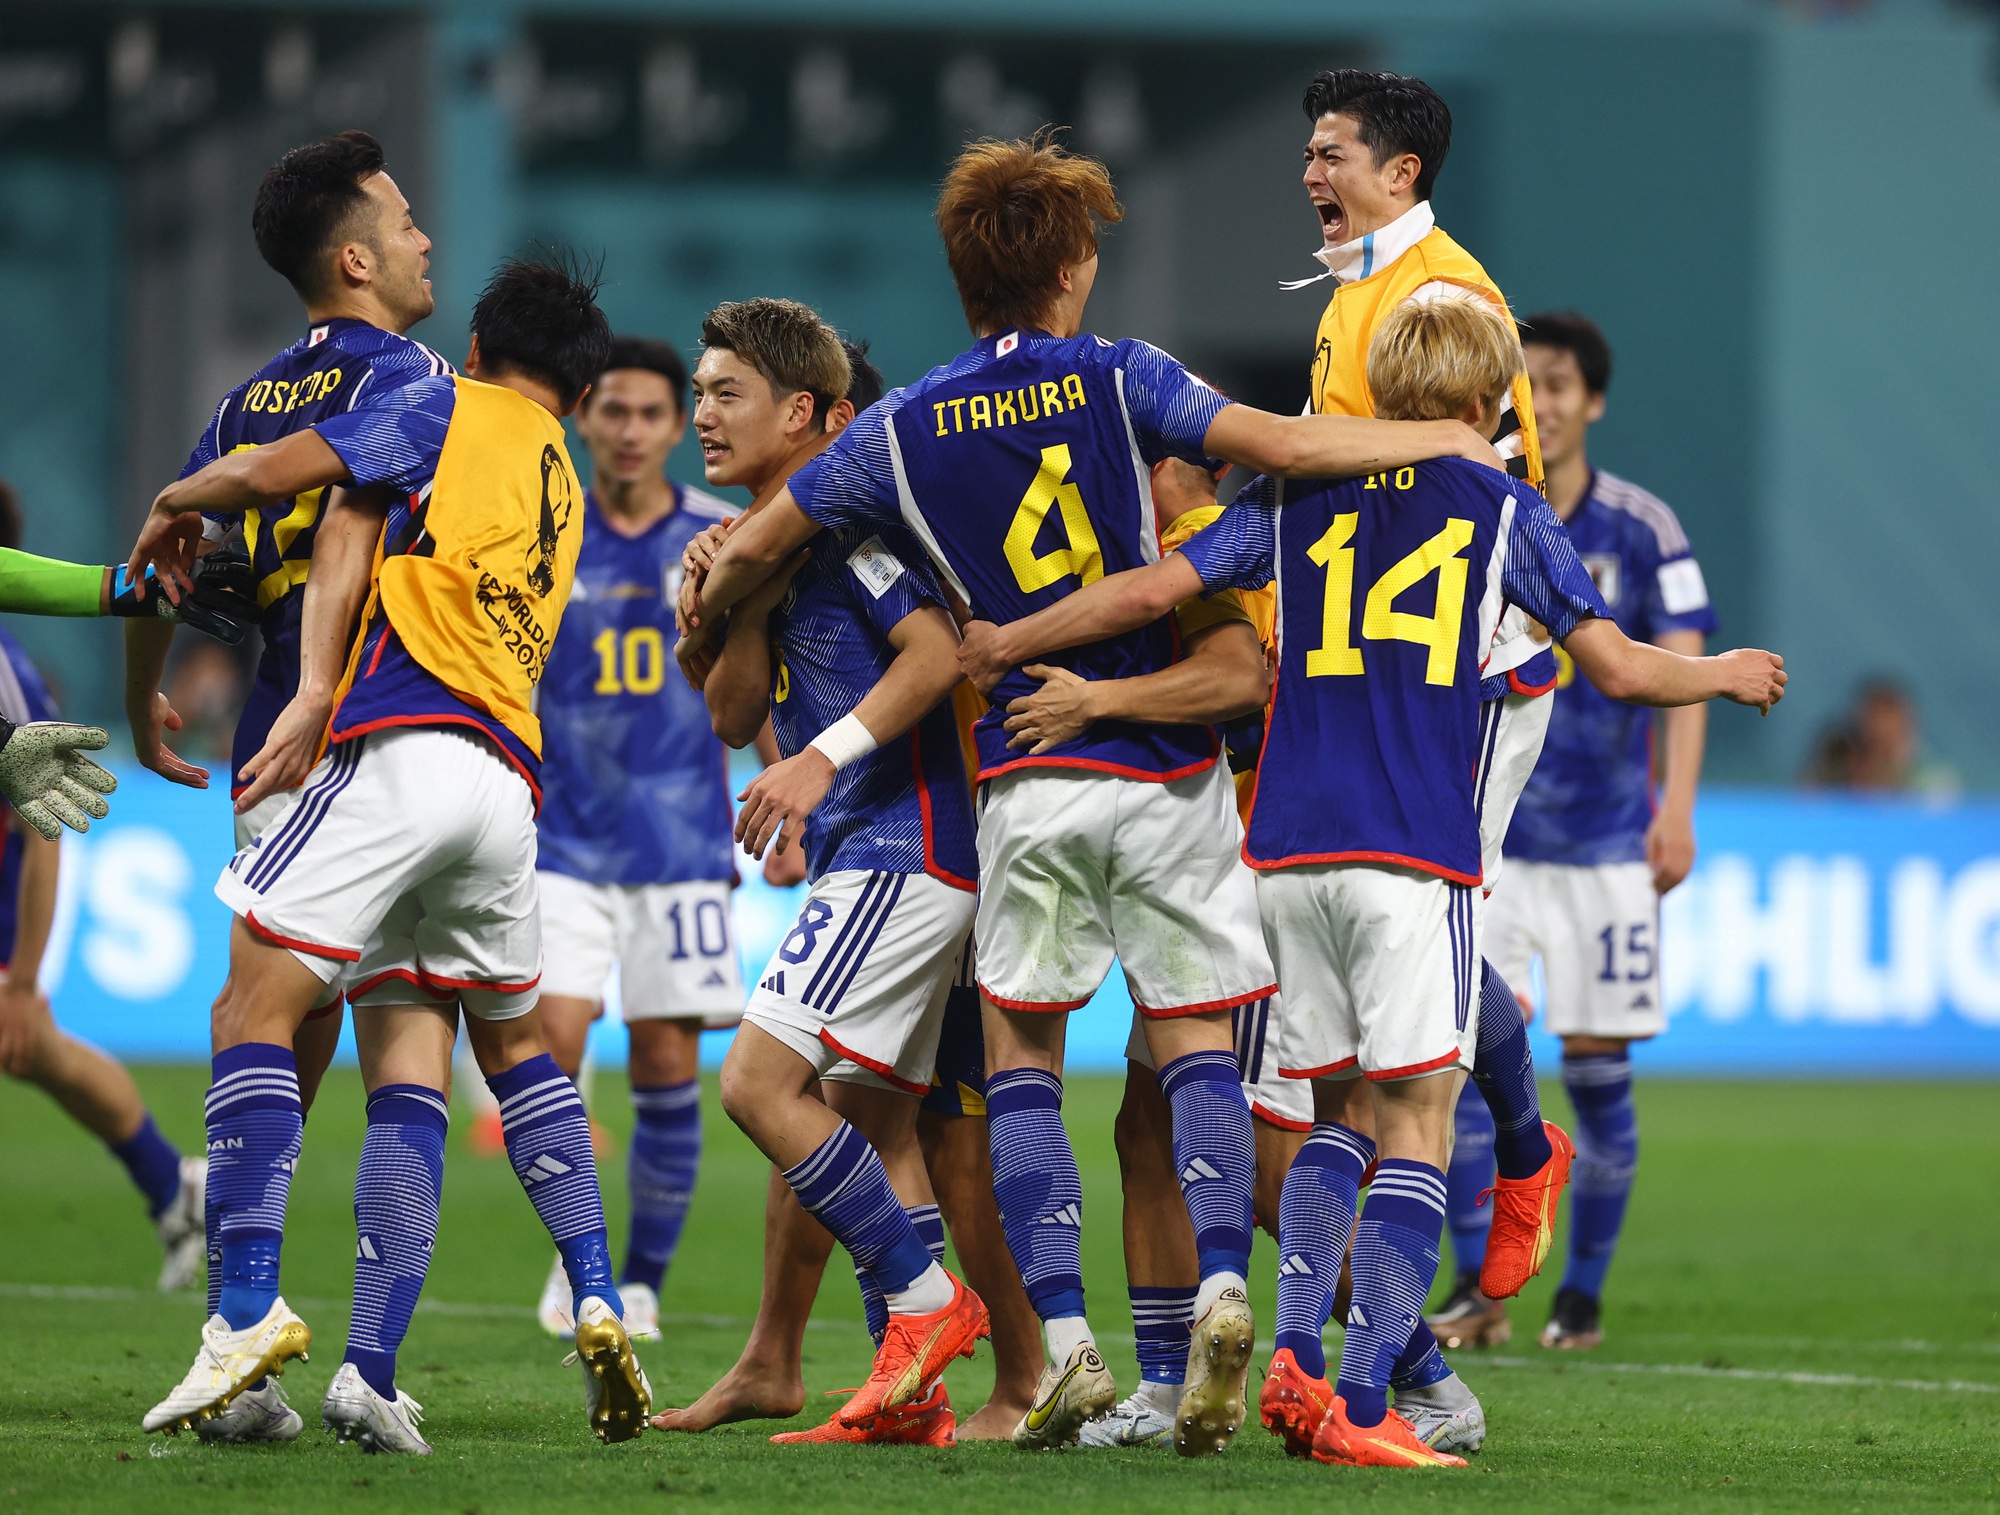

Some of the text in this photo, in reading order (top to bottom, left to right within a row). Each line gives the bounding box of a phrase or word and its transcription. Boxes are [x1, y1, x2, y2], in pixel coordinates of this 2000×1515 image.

[933, 373, 1087, 437] ITAKURA
[1003, 443, 1105, 594] 4
[504, 583, 545, 645] WORLD
[1306, 511, 1476, 687] 14
[592, 626, 665, 696] 10
[667, 900, 728, 961] 10
[780, 899, 833, 965] 8
[1597, 921, 1655, 983] 15
